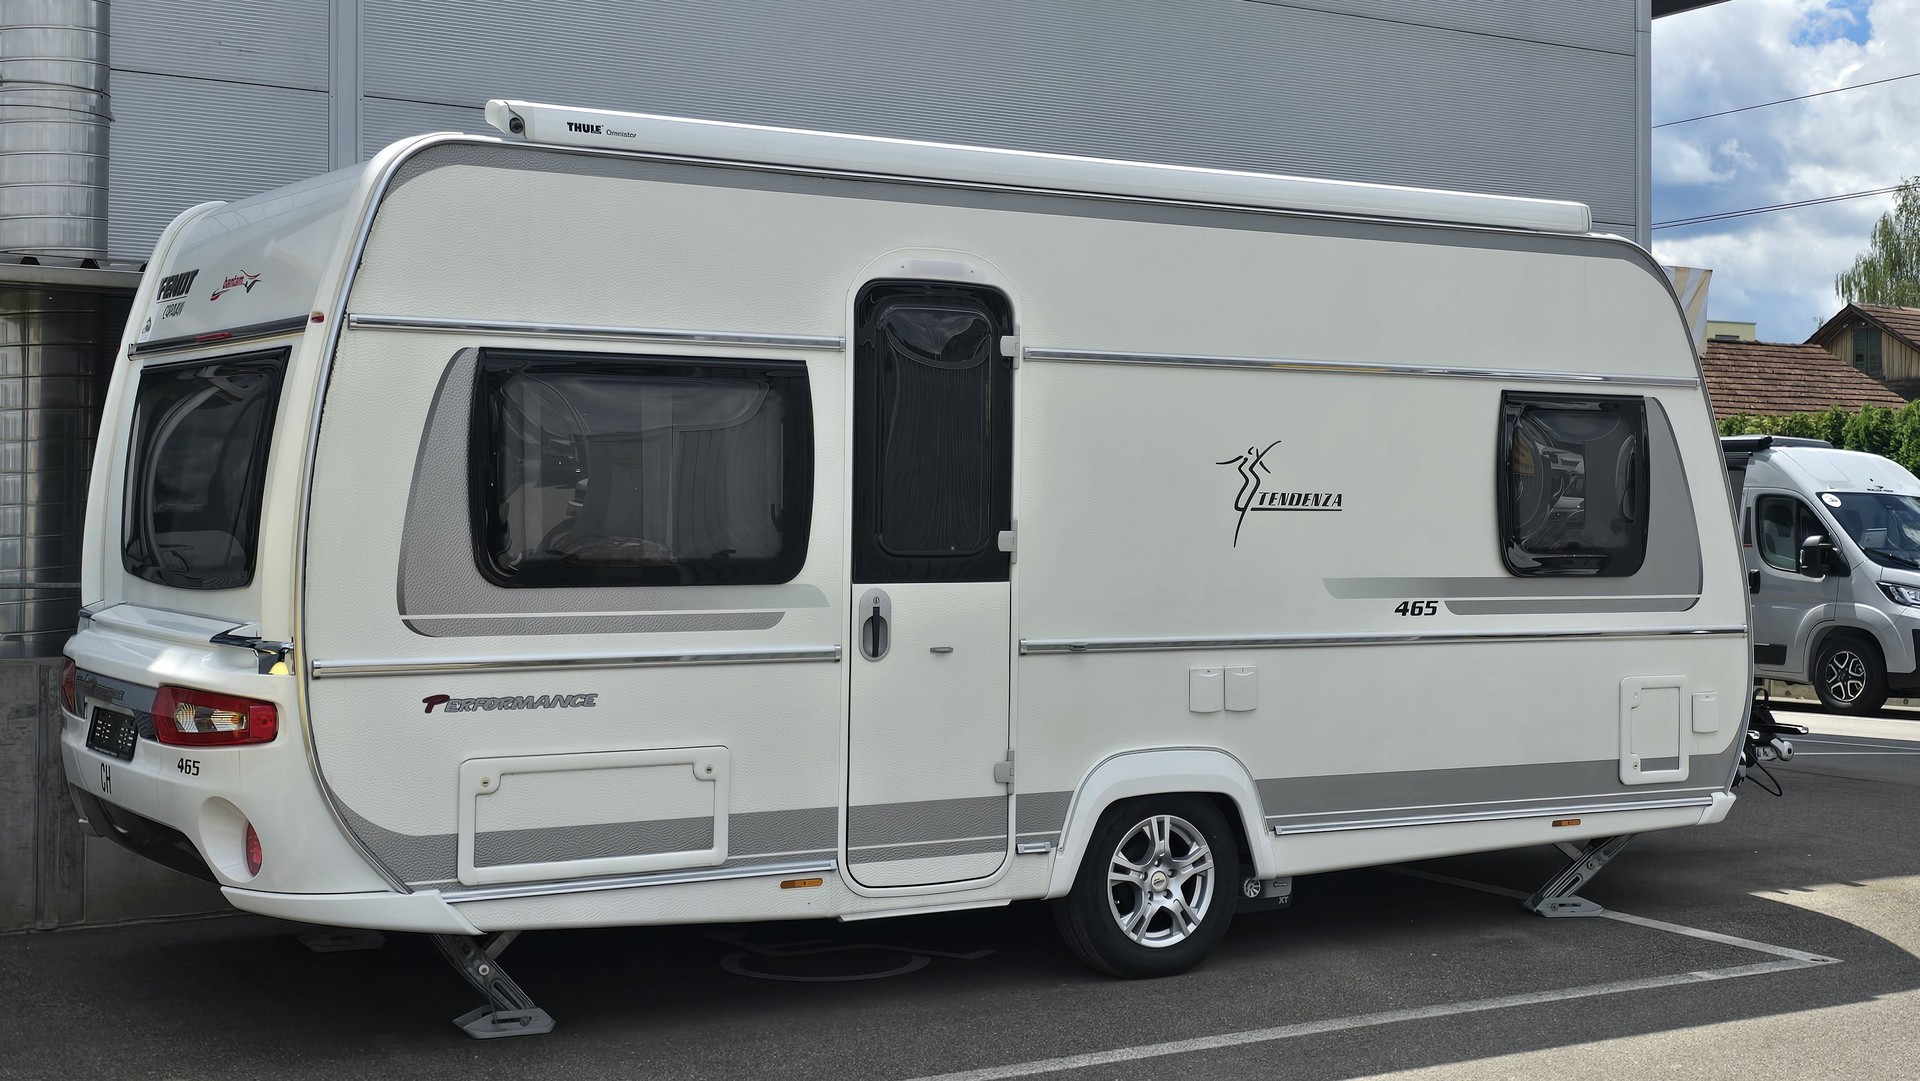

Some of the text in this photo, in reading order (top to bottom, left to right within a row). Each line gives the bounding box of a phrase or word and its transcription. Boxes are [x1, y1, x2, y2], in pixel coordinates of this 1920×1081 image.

[567, 122, 637, 138] THULE Omnistor
[157, 269, 200, 301] FENDT
[1258, 492, 1343, 507] TENDENZA
[1394, 600, 1439, 616] 465
[422, 693, 598, 713] PERFORMANCE
[177, 757, 201, 776] 465
[100, 762, 112, 794] CH
[1278, 896, 1289, 904] XT
